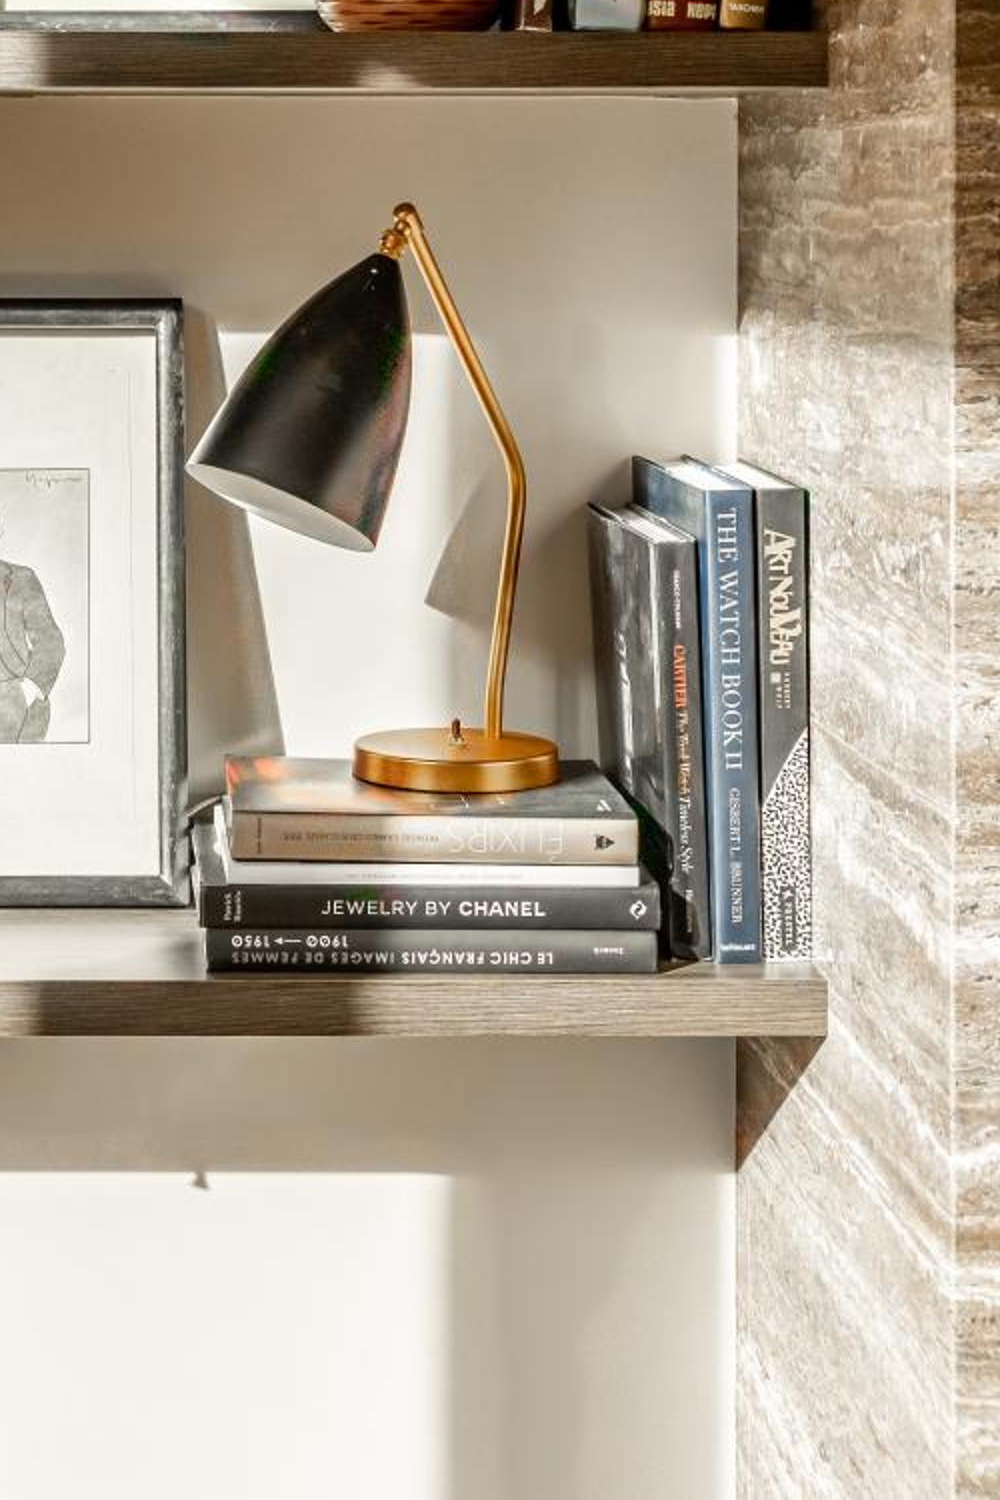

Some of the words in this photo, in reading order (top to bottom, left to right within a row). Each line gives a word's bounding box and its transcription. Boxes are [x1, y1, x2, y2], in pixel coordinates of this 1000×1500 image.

[717, 508, 739, 563] THE
[764, 529, 796, 574] ART
[718, 570, 740, 668] WATCH
[674, 644, 688, 708] CARTIER
[721, 674, 742, 746] BOOK
[725, 748, 743, 770] II
[679, 796, 693, 843] Timeless
[728, 787, 741, 840] GISBERT
[677, 845, 694, 873] Style
[730, 862, 742, 923] BRUNNER
[321, 900, 418, 916] JEWELRY
[425, 900, 451, 916] BY
[458, 900, 546, 917] CHANEL
[231, 951, 298, 964] FEMMES
[303, 952, 323, 964] DE
[330, 952, 395, 965] IMAGES
[401, 948, 484, 965] FRANÇAIS
[490, 952, 532, 965] CHIC
[537, 952, 553, 965] LE
